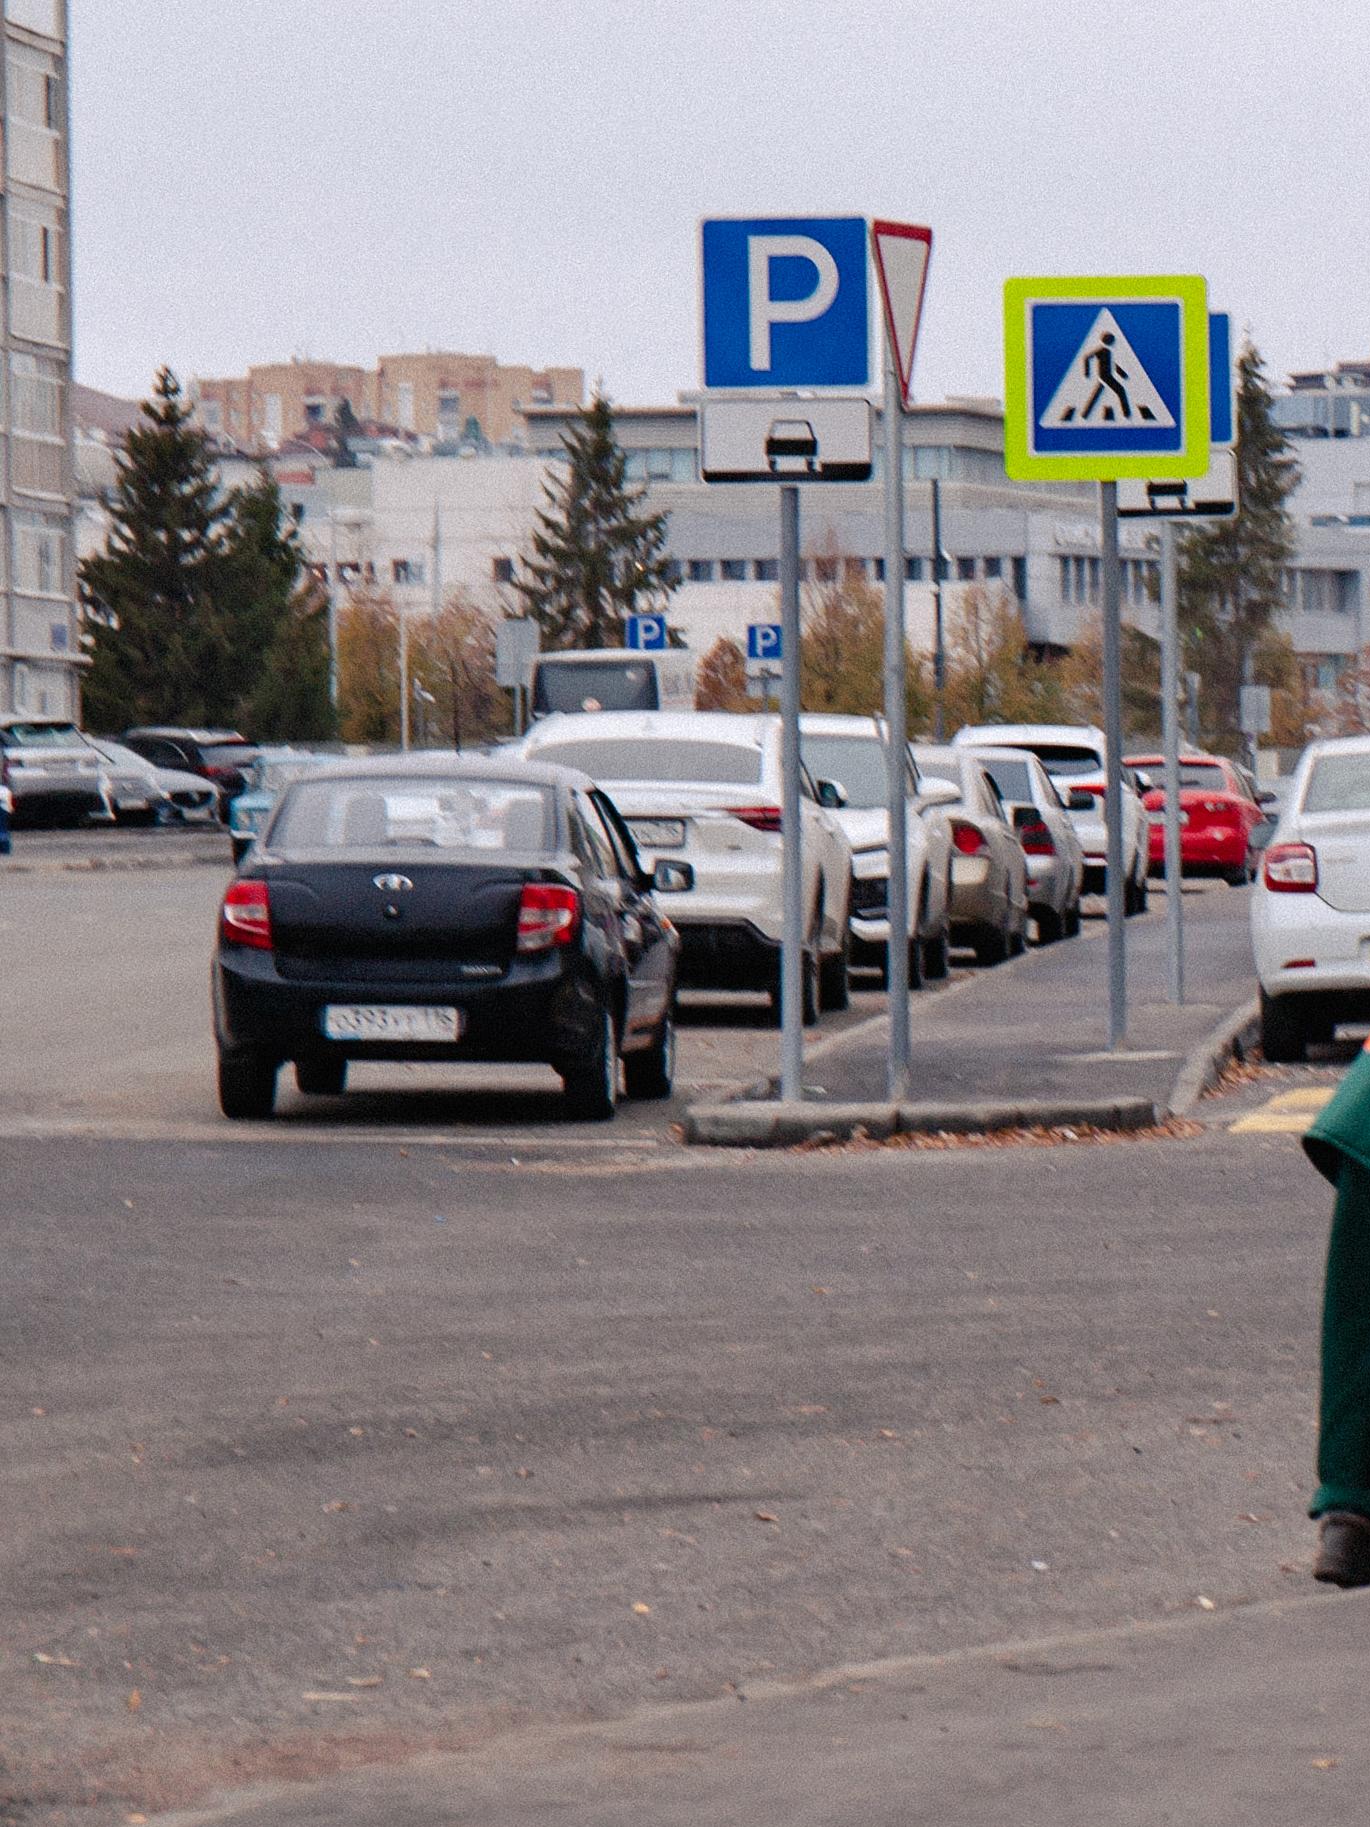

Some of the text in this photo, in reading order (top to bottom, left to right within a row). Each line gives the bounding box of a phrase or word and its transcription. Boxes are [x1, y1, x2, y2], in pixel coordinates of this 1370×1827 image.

[747, 234, 840, 371] P
[637, 617, 661, 650] P
[755, 625, 778, 657] P
